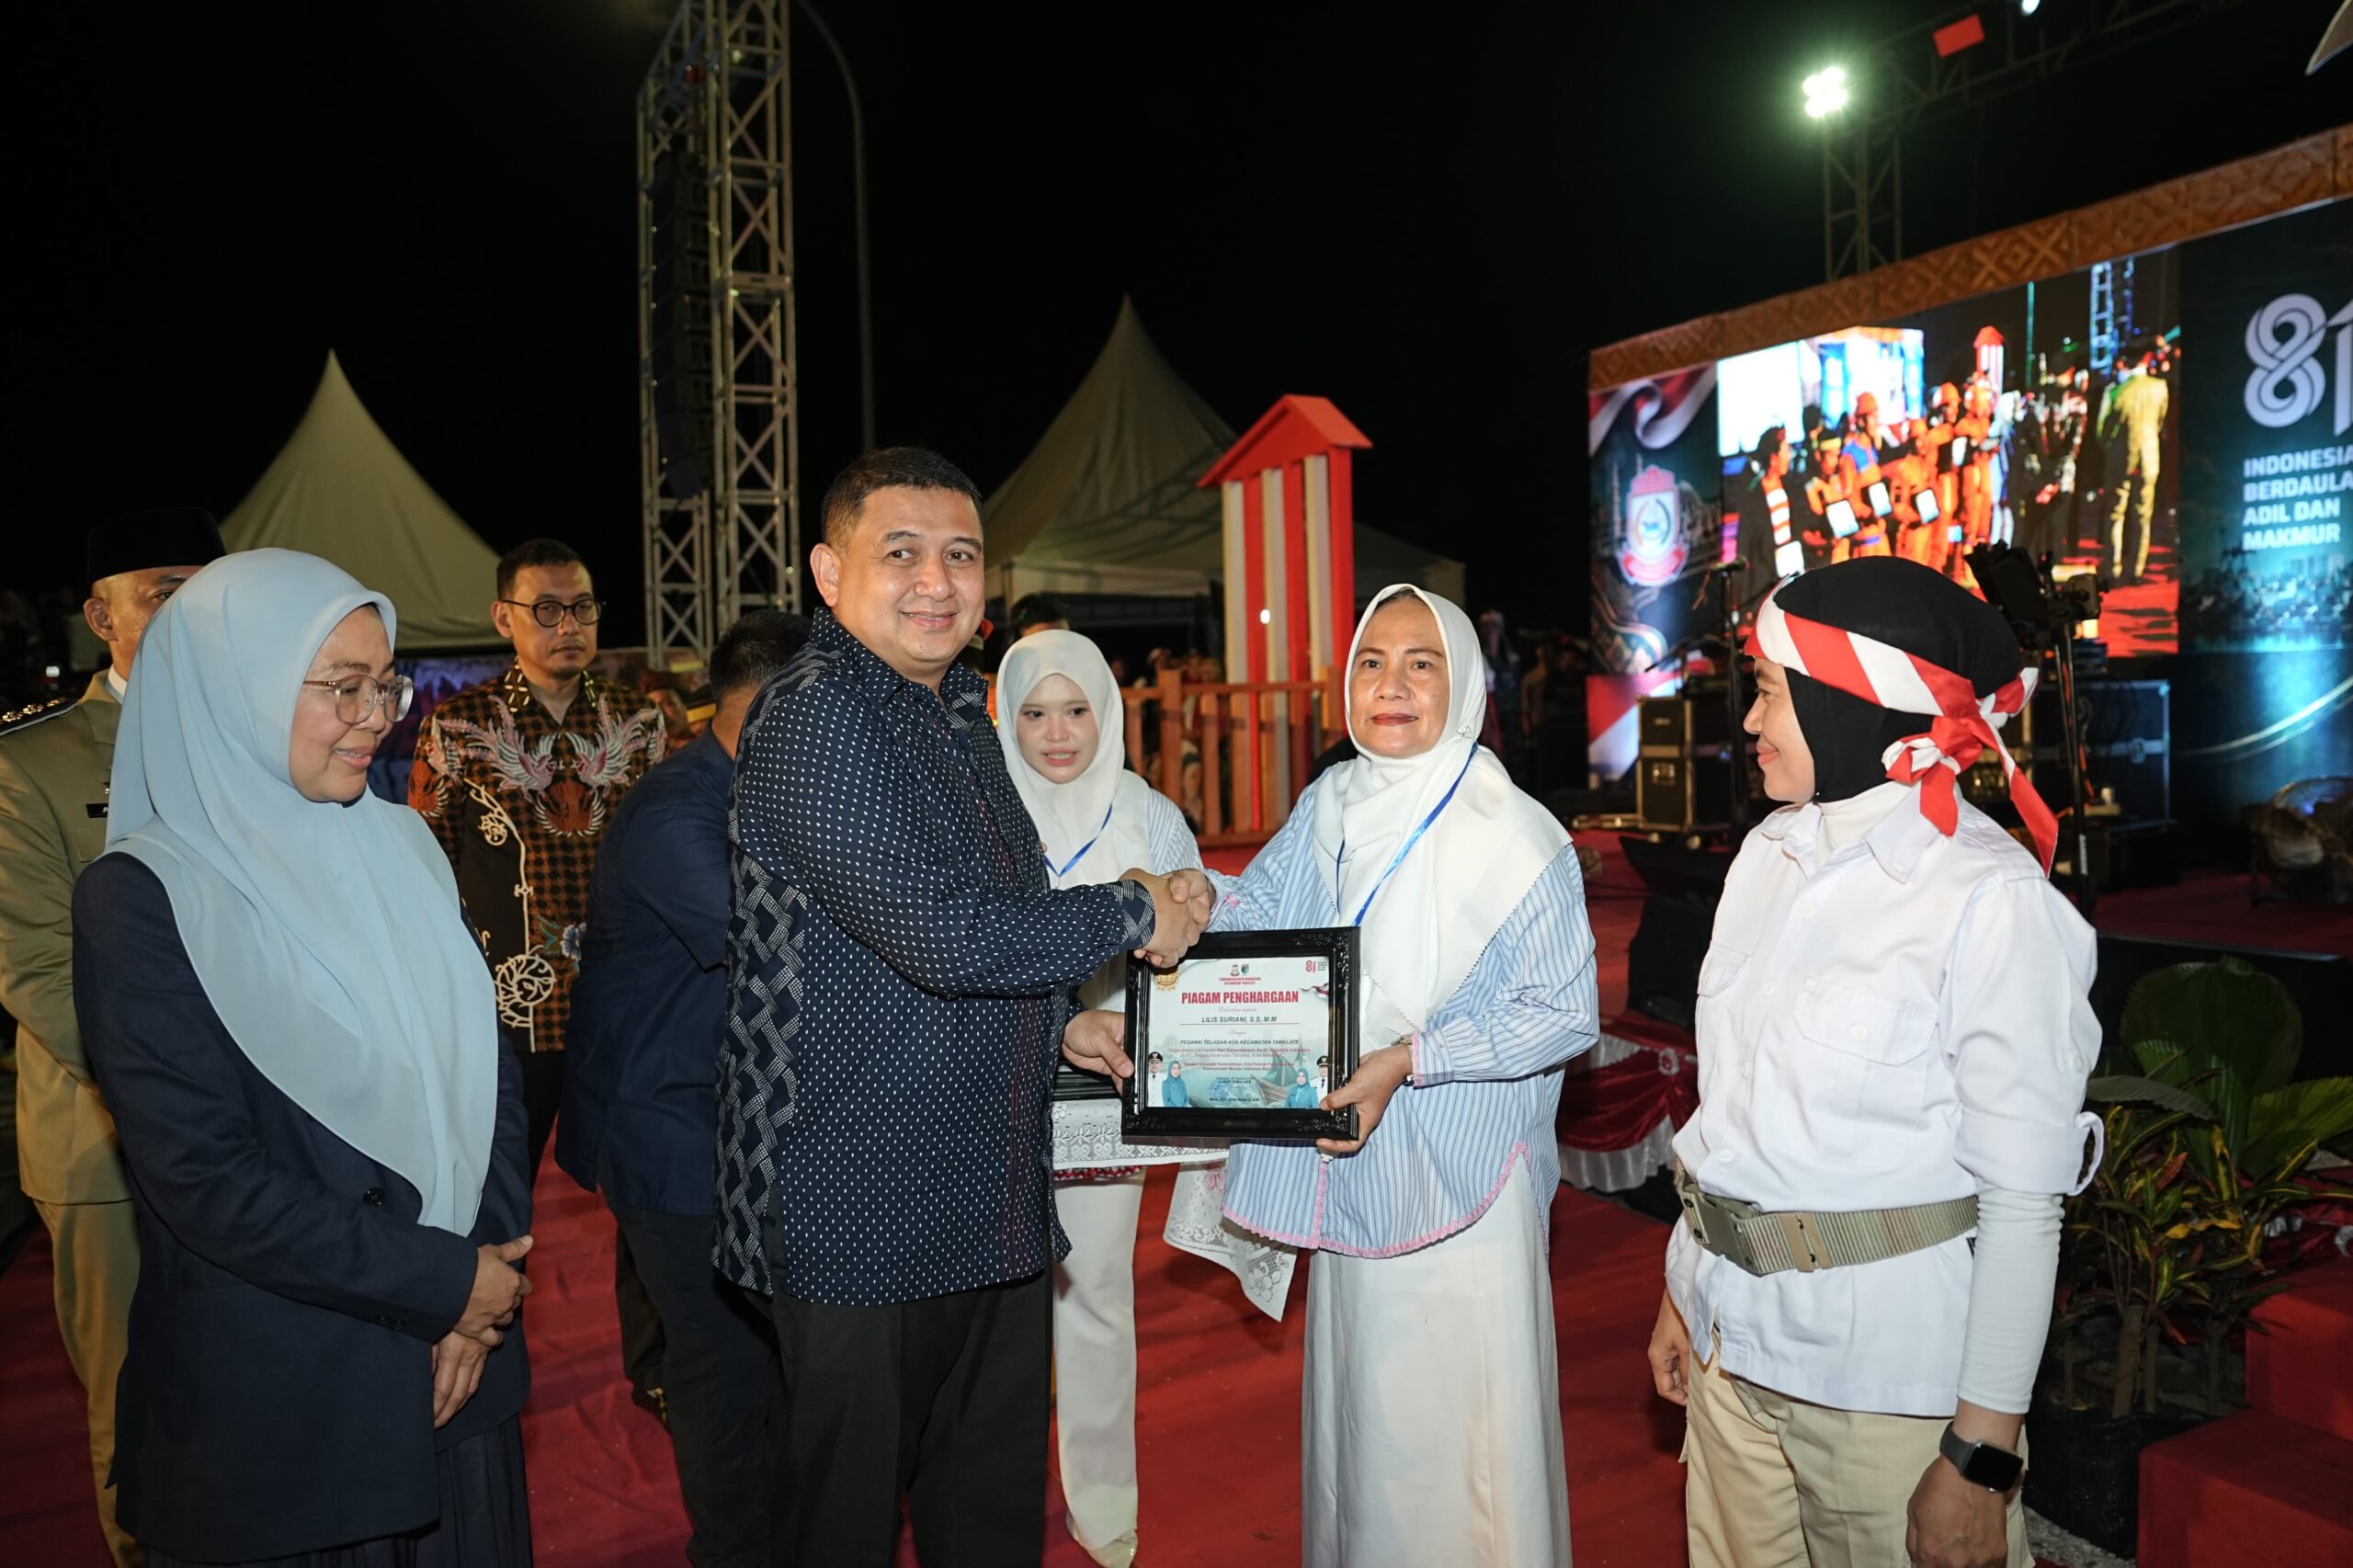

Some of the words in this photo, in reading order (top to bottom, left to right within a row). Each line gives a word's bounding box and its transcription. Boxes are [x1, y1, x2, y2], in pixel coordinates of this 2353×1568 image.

[2243, 503, 2290, 527] ADIL
[2294, 496, 2340, 521] DAN
[2243, 523, 2340, 551] MAKMUR
[1181, 992, 1221, 1004] PIAGAM
[1223, 991, 1299, 1004] PENGHARGAAN
